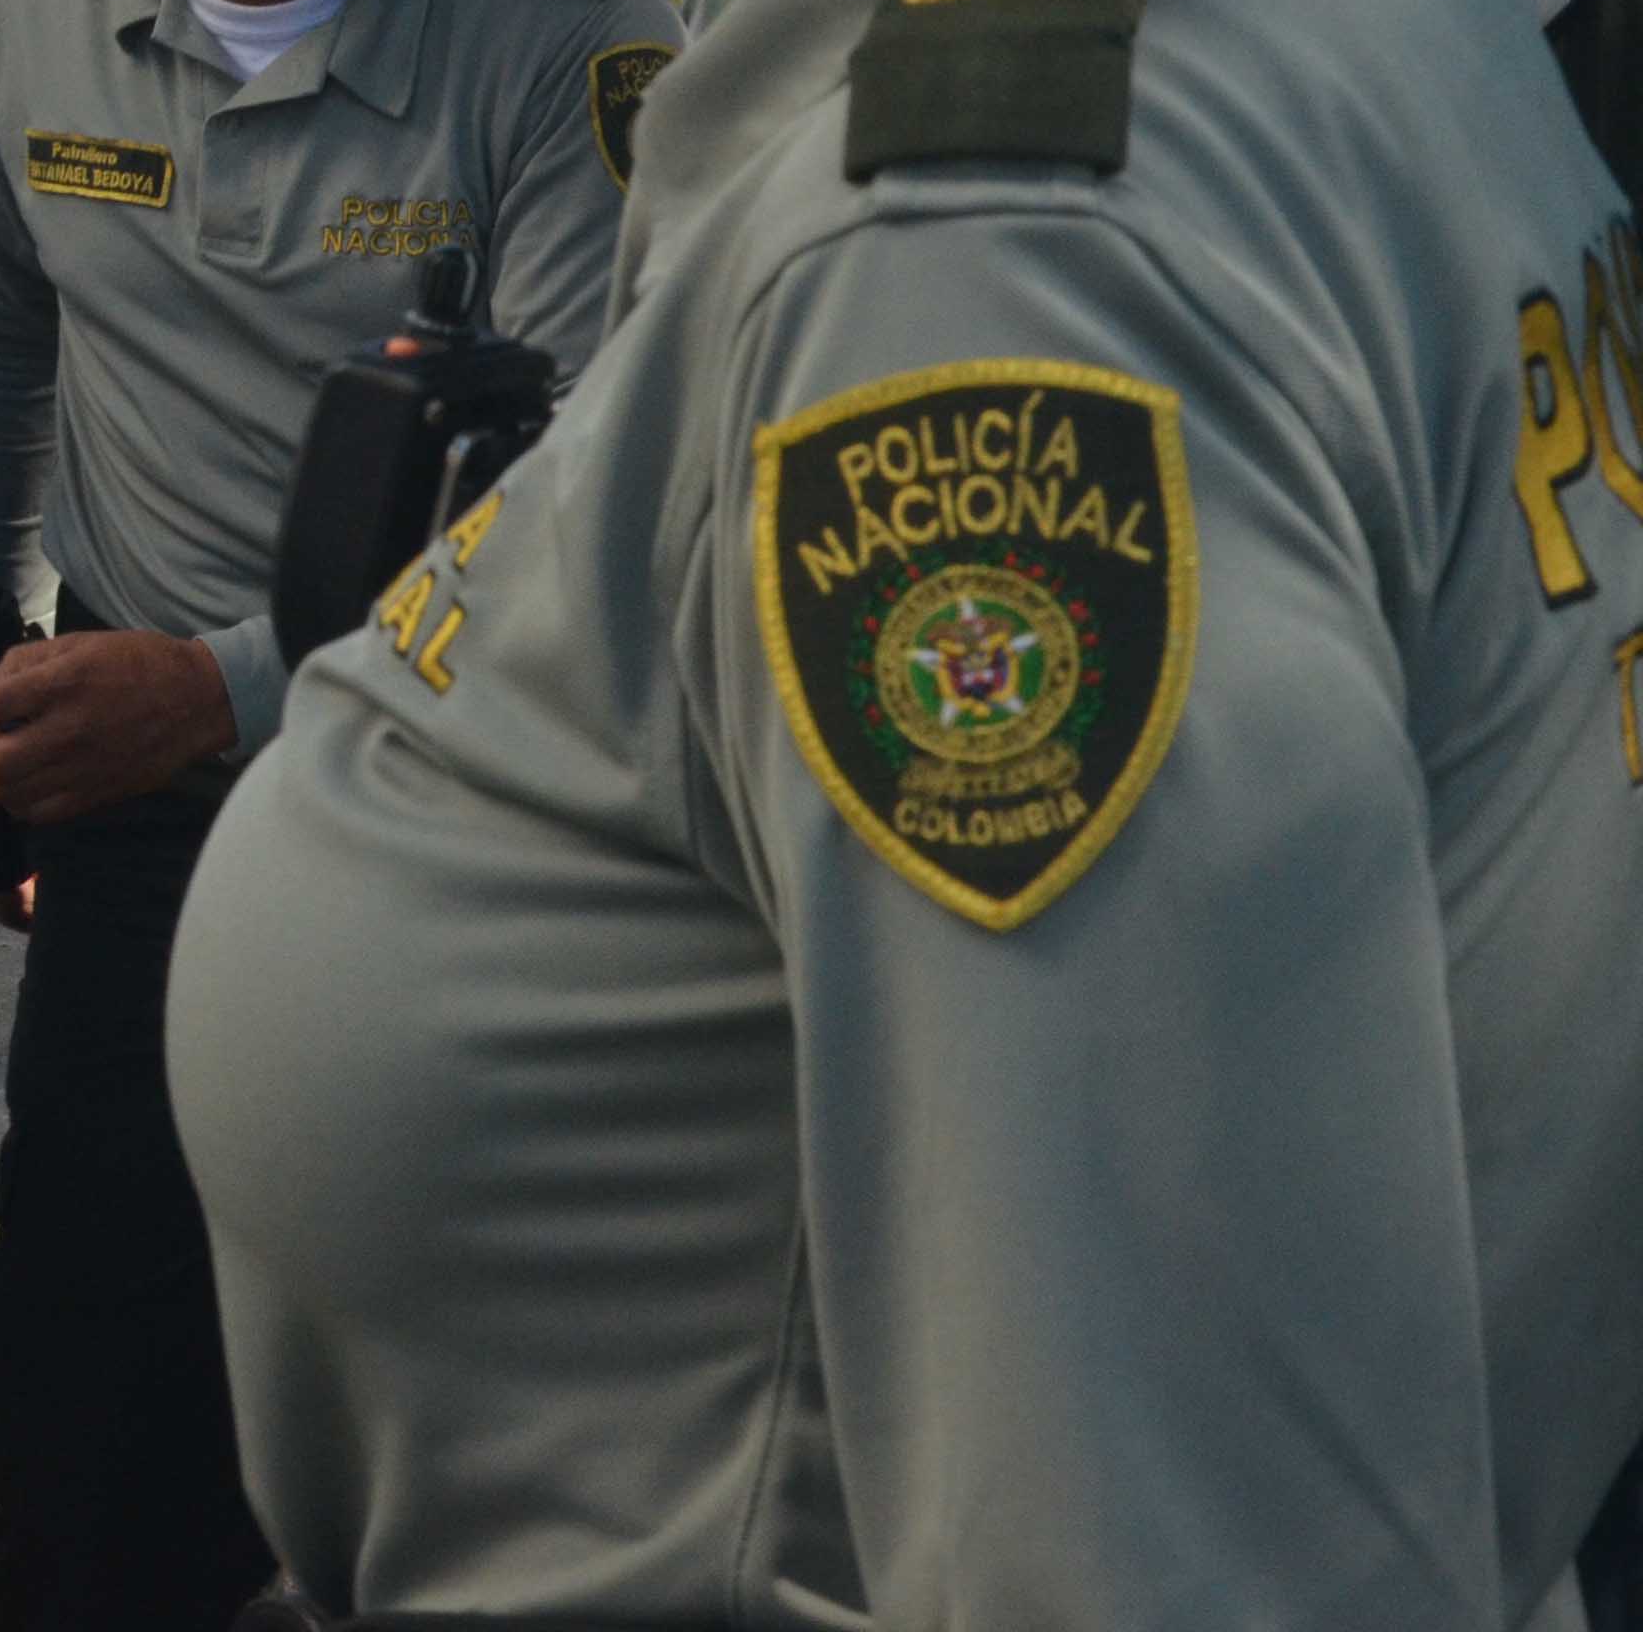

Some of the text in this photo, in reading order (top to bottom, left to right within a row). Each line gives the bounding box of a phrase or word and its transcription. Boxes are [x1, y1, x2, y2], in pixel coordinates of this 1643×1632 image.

[92, 168, 154, 195] BEDOYA
[836, 389, 1080, 506] POLICÍA
[797, 474, 1153, 596] NACIONAL
[892, 790, 1088, 847] COLOMBIA
